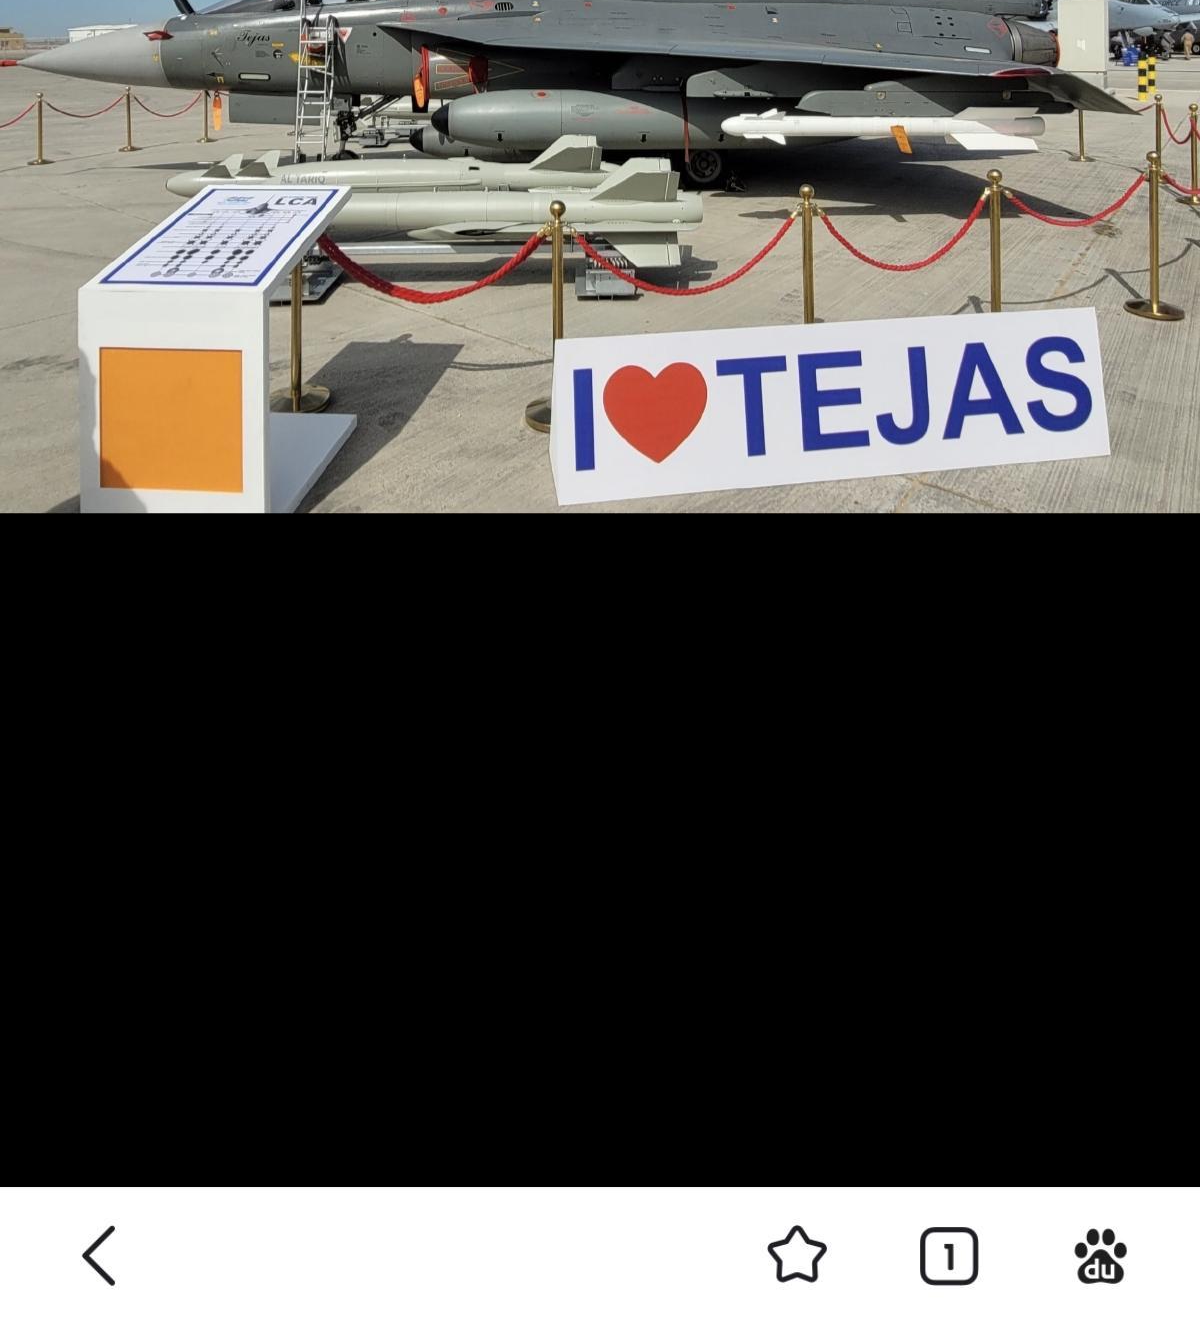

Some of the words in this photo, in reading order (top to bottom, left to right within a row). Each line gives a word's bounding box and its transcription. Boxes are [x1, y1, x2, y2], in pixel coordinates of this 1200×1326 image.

[237, 29, 271, 47] Tejas
[274, 196, 318, 206] LCA
[573, 368, 596, 472] I
[715, 335, 1094, 458] TEJAS
[943, 1243, 955, 1271] 1
[1084, 1257, 1116, 1280] du
